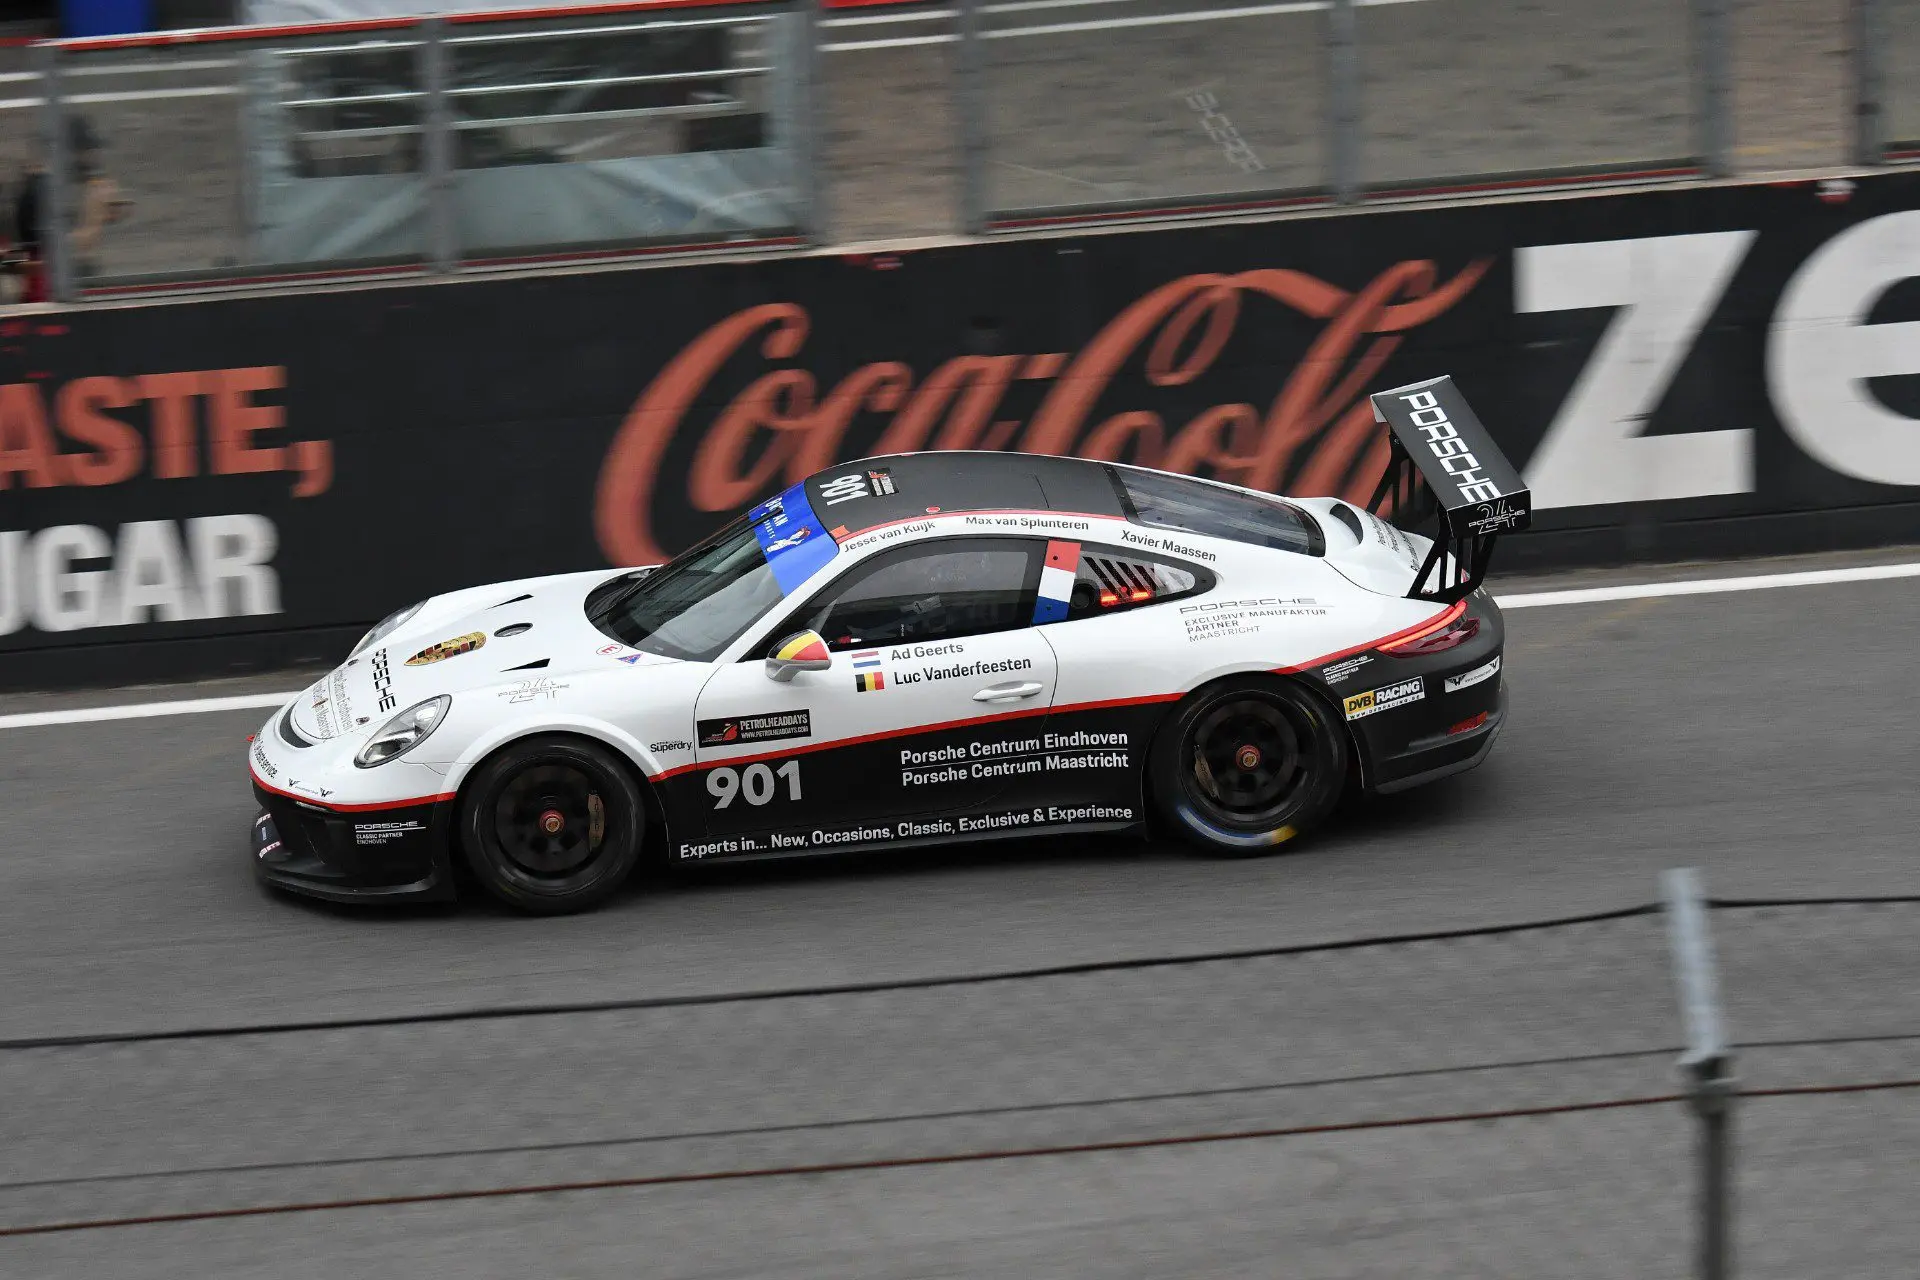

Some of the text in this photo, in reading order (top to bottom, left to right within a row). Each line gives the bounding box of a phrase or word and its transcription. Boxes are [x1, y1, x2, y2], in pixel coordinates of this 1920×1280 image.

[1398, 390, 1502, 503] PORSCHE
[819, 474, 869, 506] 901
[965, 516, 1090, 531] Max van Splunteren
[1468, 510, 1526, 528] PORSCHE
[843, 521, 936, 553] Jesse van Kuijk
[1121, 530, 1217, 562] Xavier Maassen
[1179, 597, 1317, 614] PORSCHE
[1184, 608, 1327, 627] EXCLUSIVE MANUFAKTUR
[1187, 620, 1239, 634] PARTNER
[1189, 625, 1261, 642] MAASTRICHT
[891, 643, 964, 661] Ad Geerts
[894, 657, 1032, 686] Luc Vanderfeesten
[1348, 680, 1420, 712] DVB RACING
[740, 714, 808, 730] PETROLHEADDAYS
[650, 740, 693, 754] Superdry
[900, 730, 1128, 765] Porsche Centrum Eindhoven
[902, 752, 1129, 787] Porsche Centrum Maastricht
[706, 759, 802, 810] 901
[354, 820, 418, 830] PORSCHE
[680, 805, 1133, 859] Experts in... New, Occasions, Classic, Exclusive & Experience
